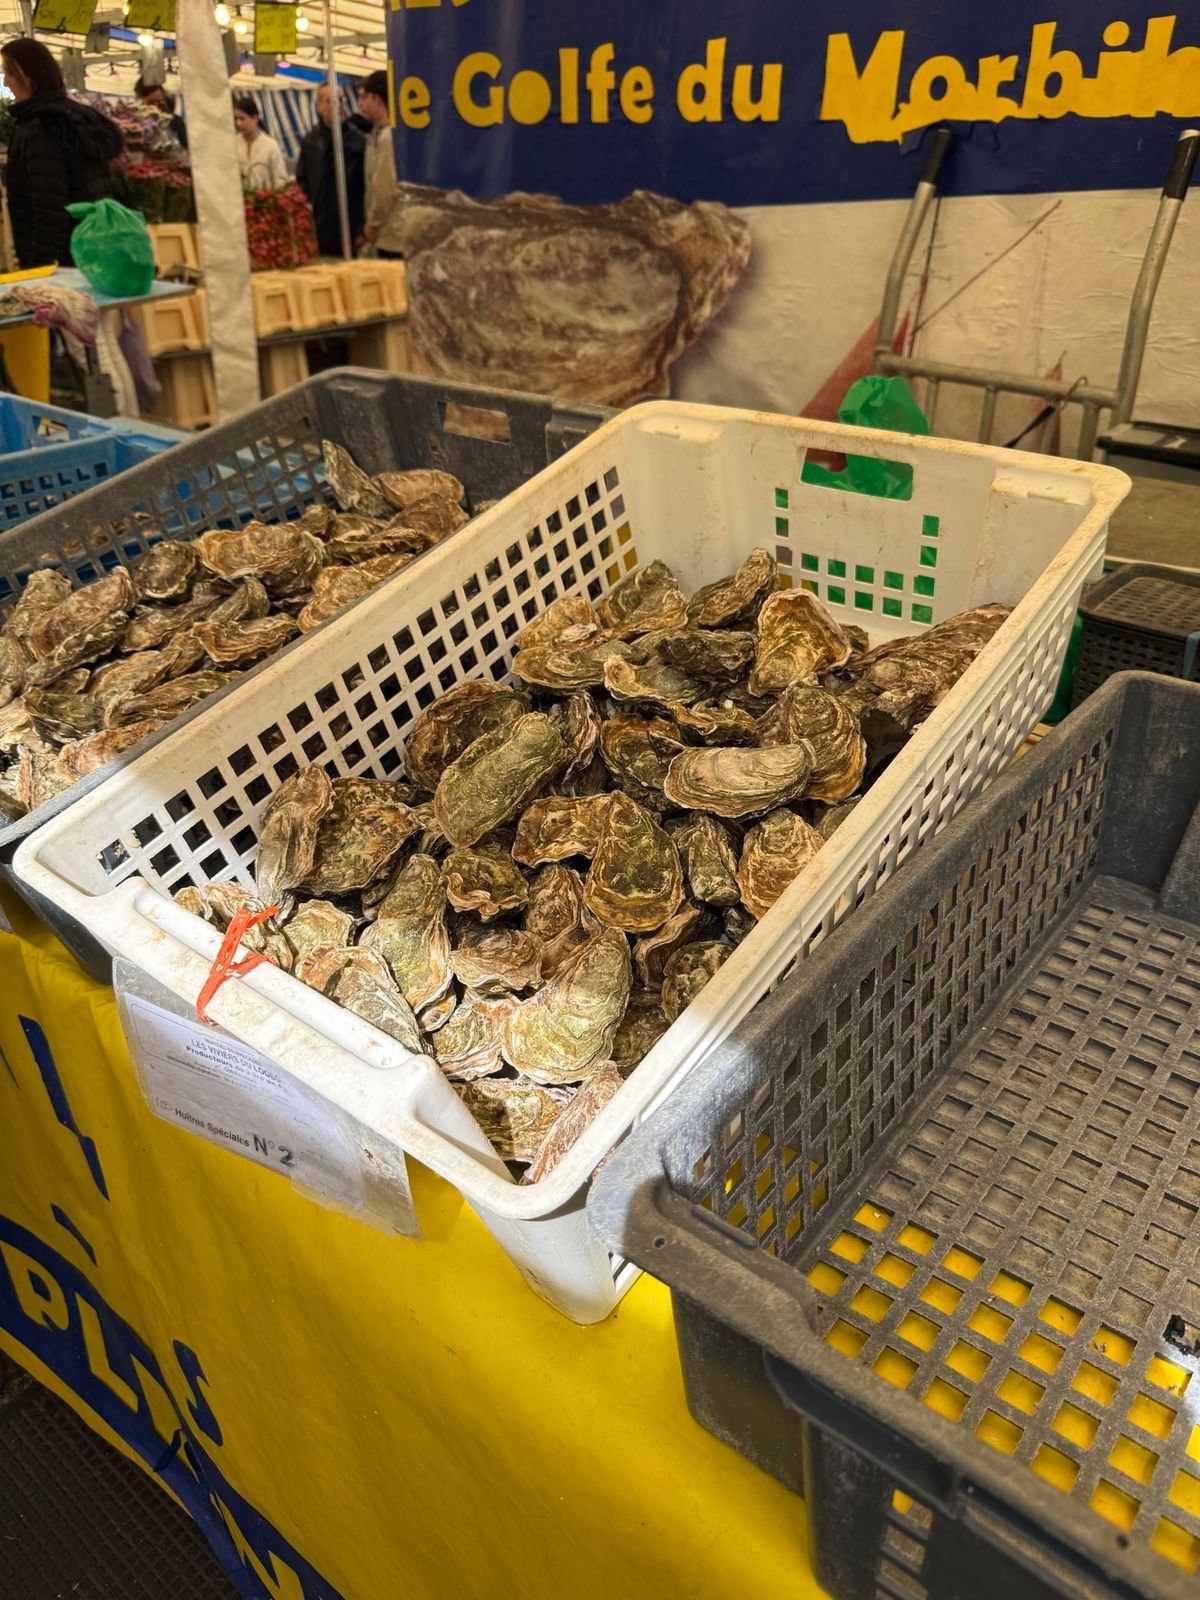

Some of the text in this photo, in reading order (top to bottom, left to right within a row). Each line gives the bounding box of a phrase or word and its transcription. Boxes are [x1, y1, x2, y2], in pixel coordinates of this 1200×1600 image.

[452, 42, 654, 127] Golfe
[676, 37, 783, 123] du
[207, 1121, 250, 1147] Spéciales
[278, 1145, 296, 1168] 2
